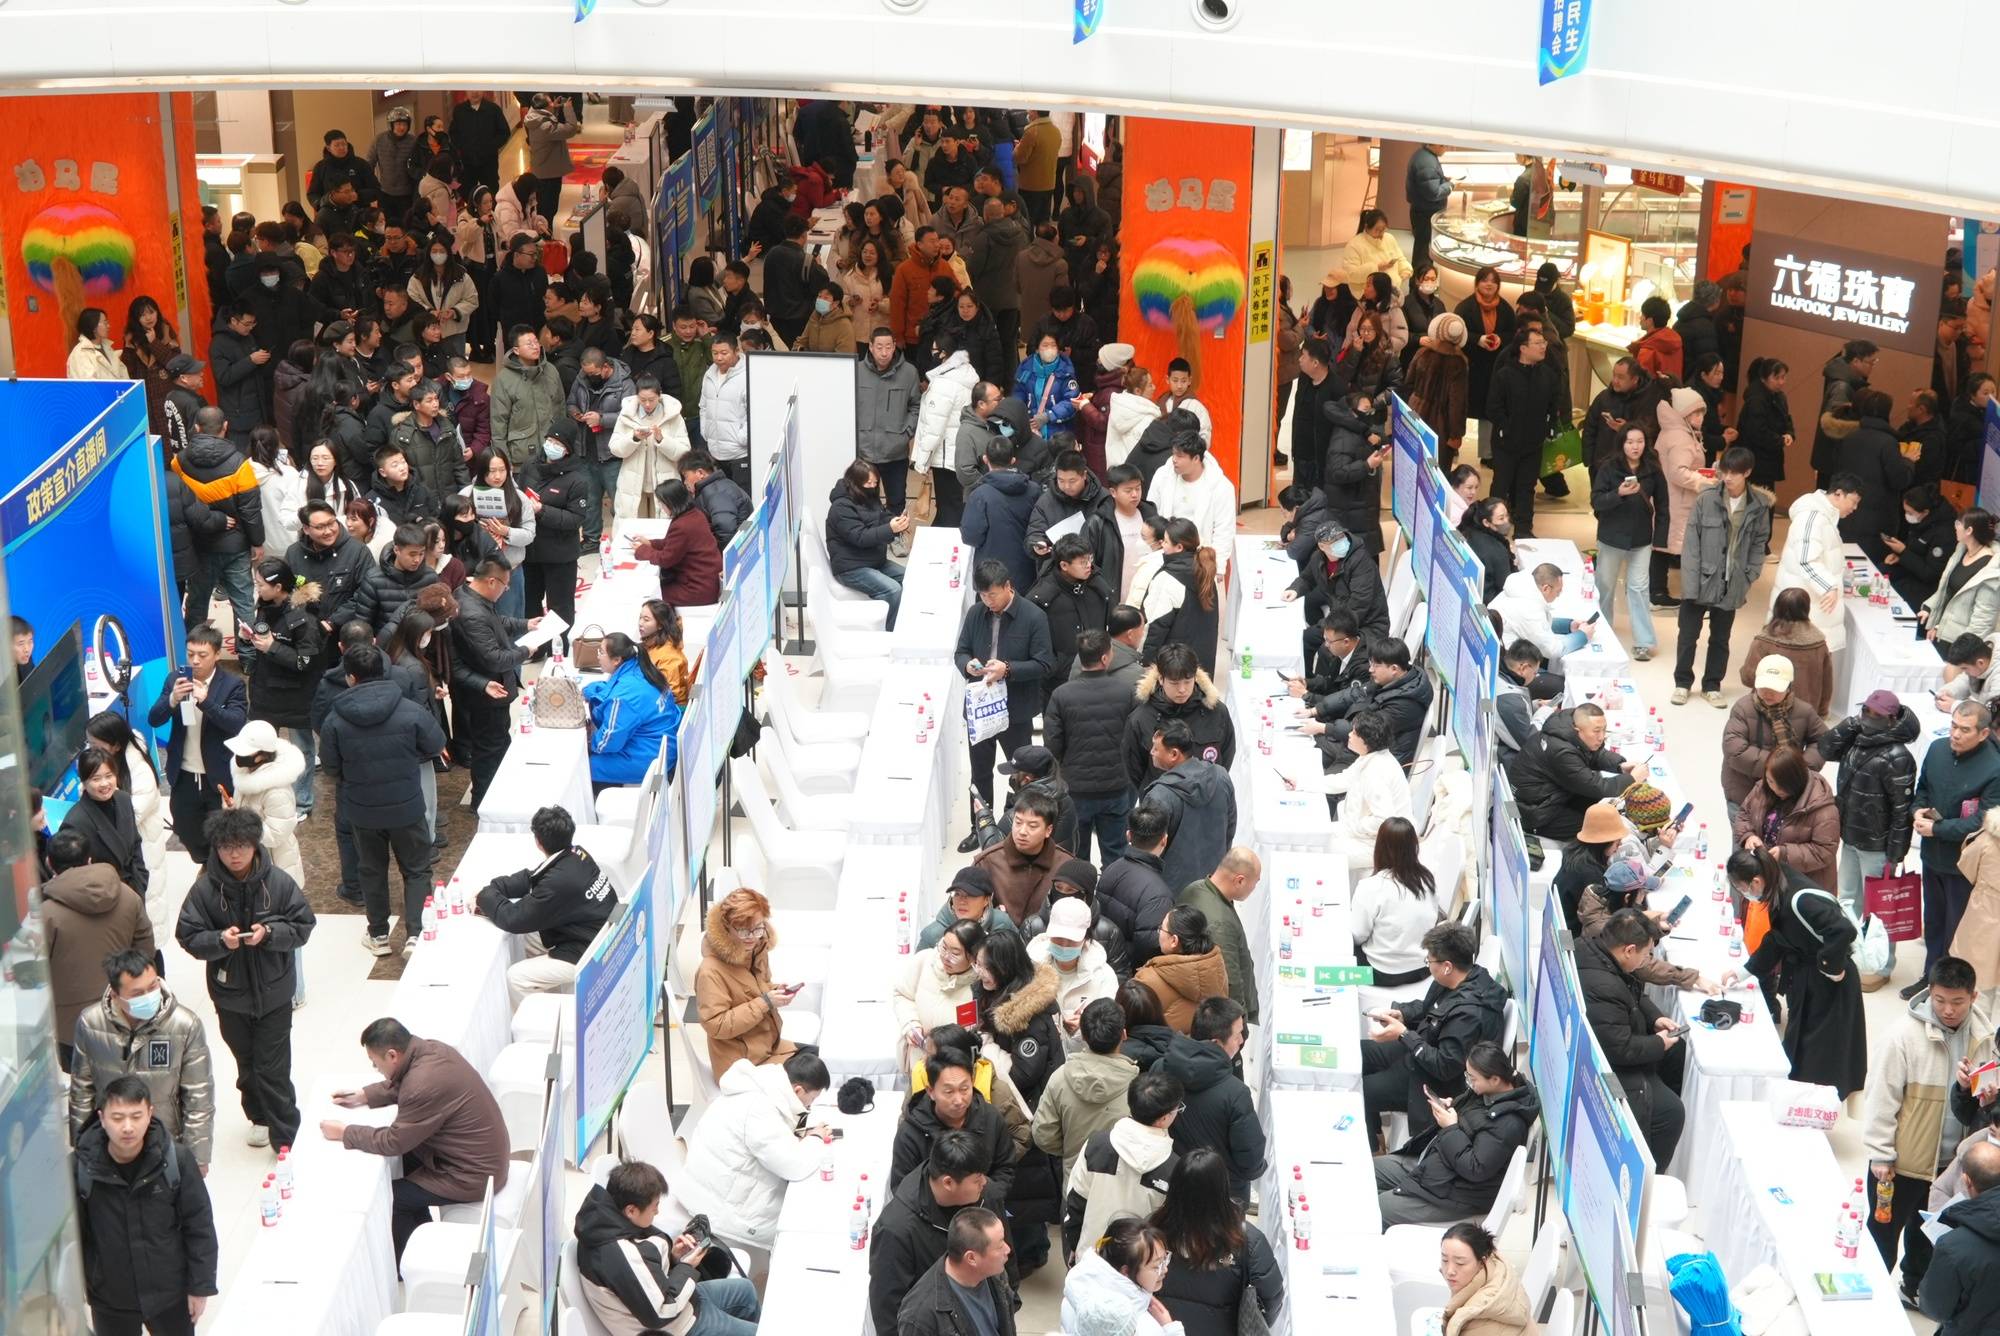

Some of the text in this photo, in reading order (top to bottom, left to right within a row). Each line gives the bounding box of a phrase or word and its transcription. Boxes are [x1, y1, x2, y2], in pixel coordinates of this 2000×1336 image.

[1251, 275, 1261, 336] 防火卷帘门
[1260, 274, 1270, 333] 下严禁堆物
[1770, 292, 1910, 334] LUKFOOK JEWELLERY
[1772, 254, 1916, 318] 六福珠寶
[25, 426, 107, 525] 政策宣介直播间
